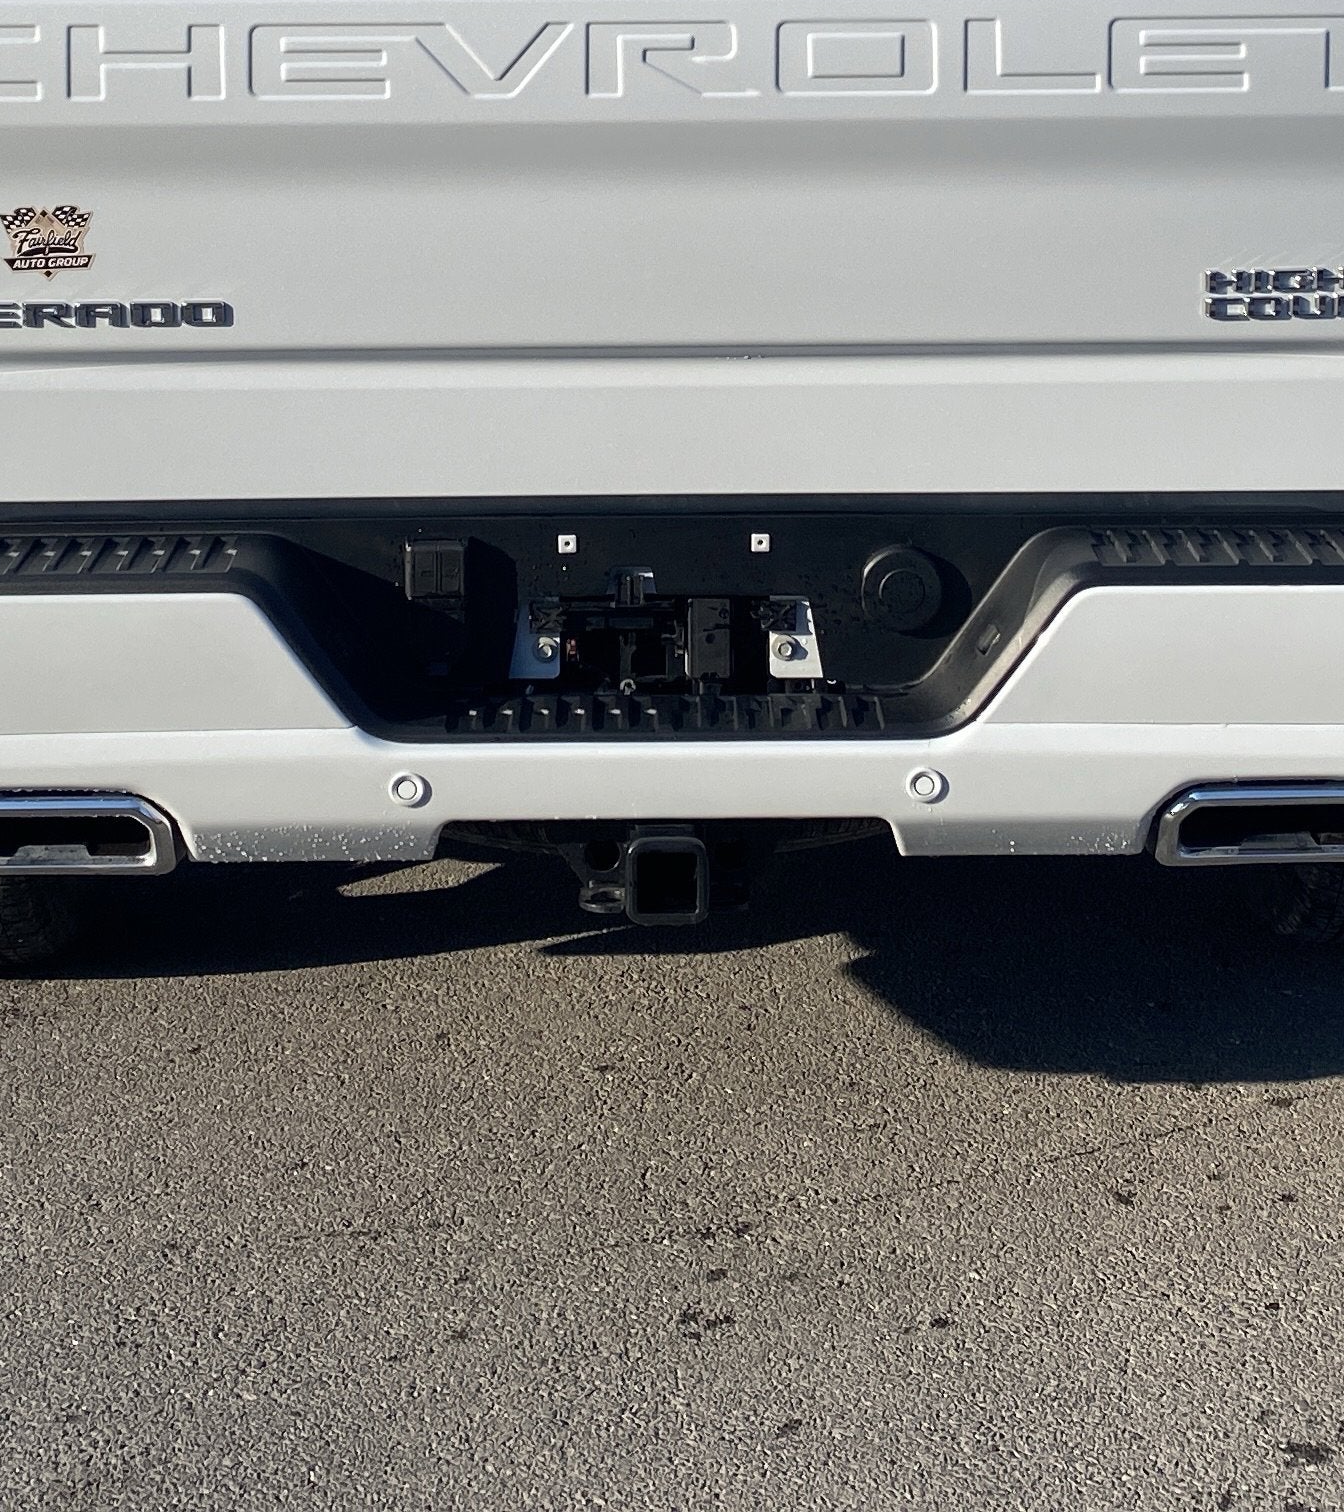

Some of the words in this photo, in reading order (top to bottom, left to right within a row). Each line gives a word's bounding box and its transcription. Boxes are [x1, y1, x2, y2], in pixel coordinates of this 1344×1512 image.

[13, 228, 82, 256] Fairfield
[12, 258, 46, 269] AUTO
[47, 256, 89, 268] GROUP
